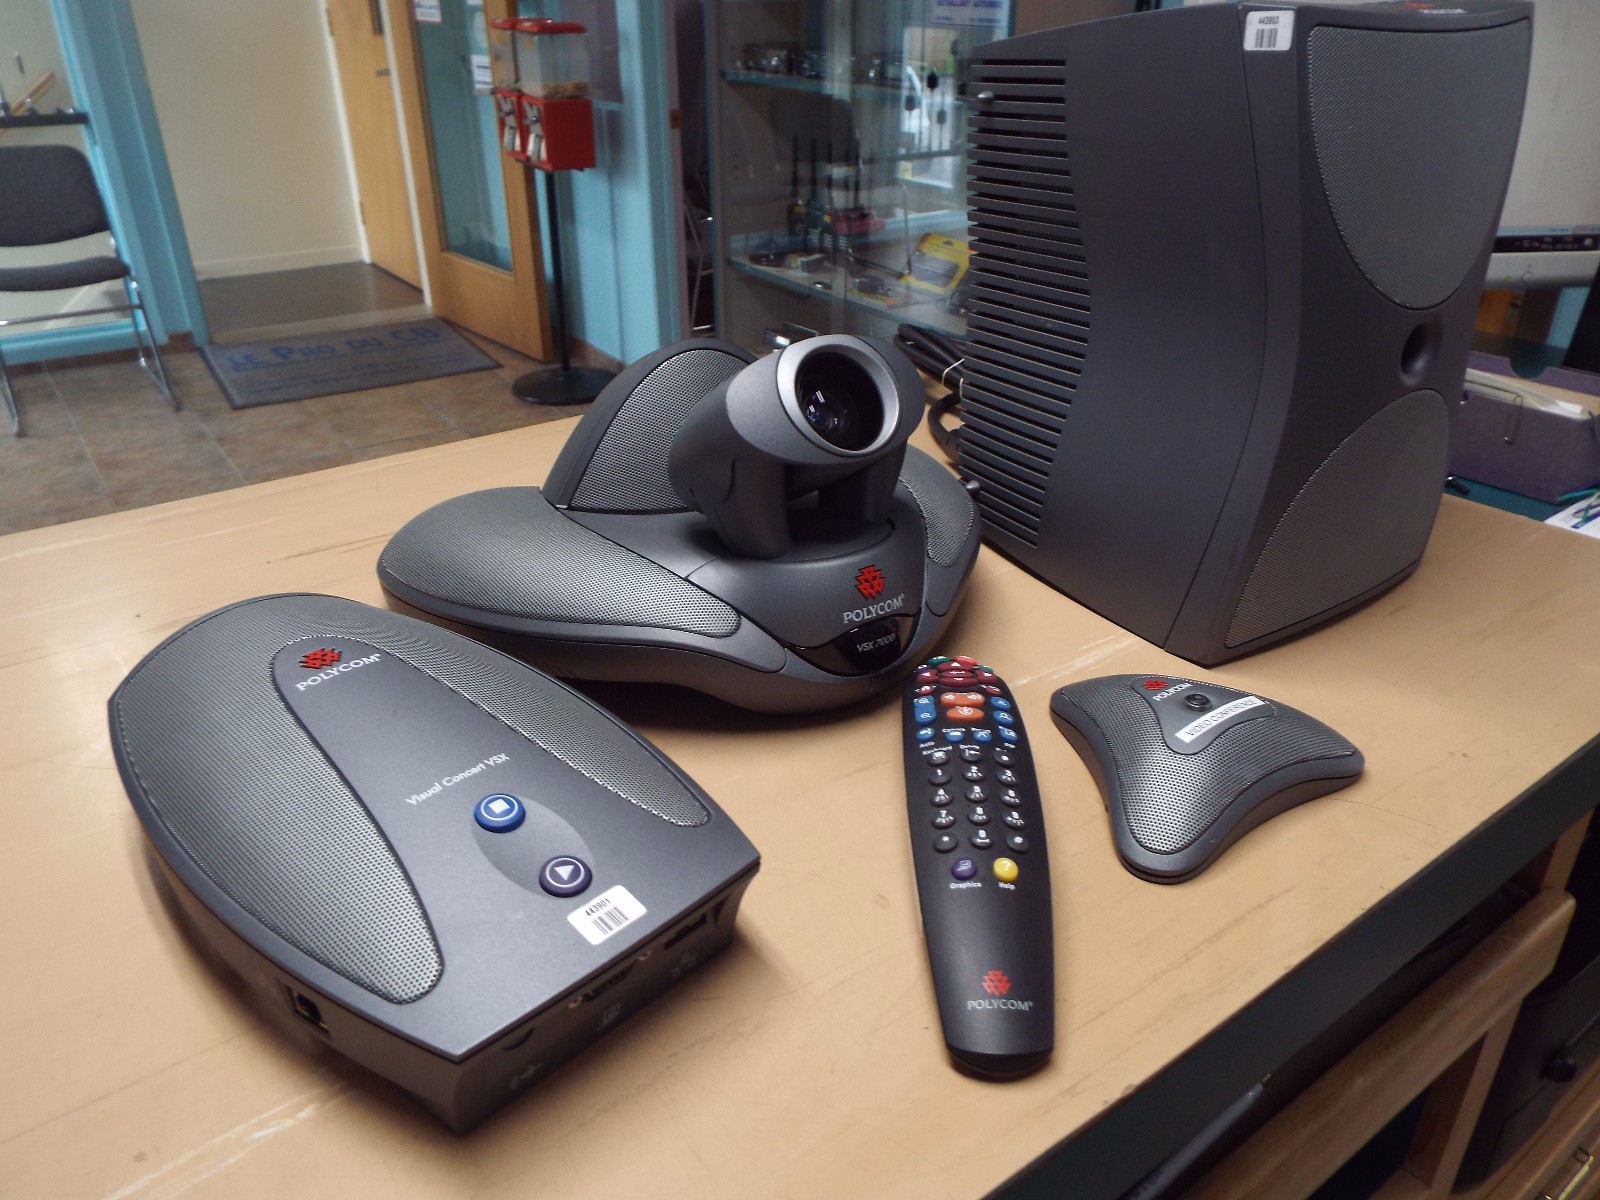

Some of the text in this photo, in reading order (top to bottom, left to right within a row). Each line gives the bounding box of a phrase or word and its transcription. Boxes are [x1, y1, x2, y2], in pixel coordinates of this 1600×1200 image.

[843, 594, 904, 623] POLYCOM
[857, 641, 874, 652] VSX
[295, 653, 381, 691] POLYCOM
[1152, 682, 1193, 701] POLYCOM
[1185, 719, 1212, 737] VIDEO
[405, 752, 510, 805] Visual Concert VSX
[584, 898, 611, 916] 443901
[967, 999, 1031, 1011] POLYCOM
